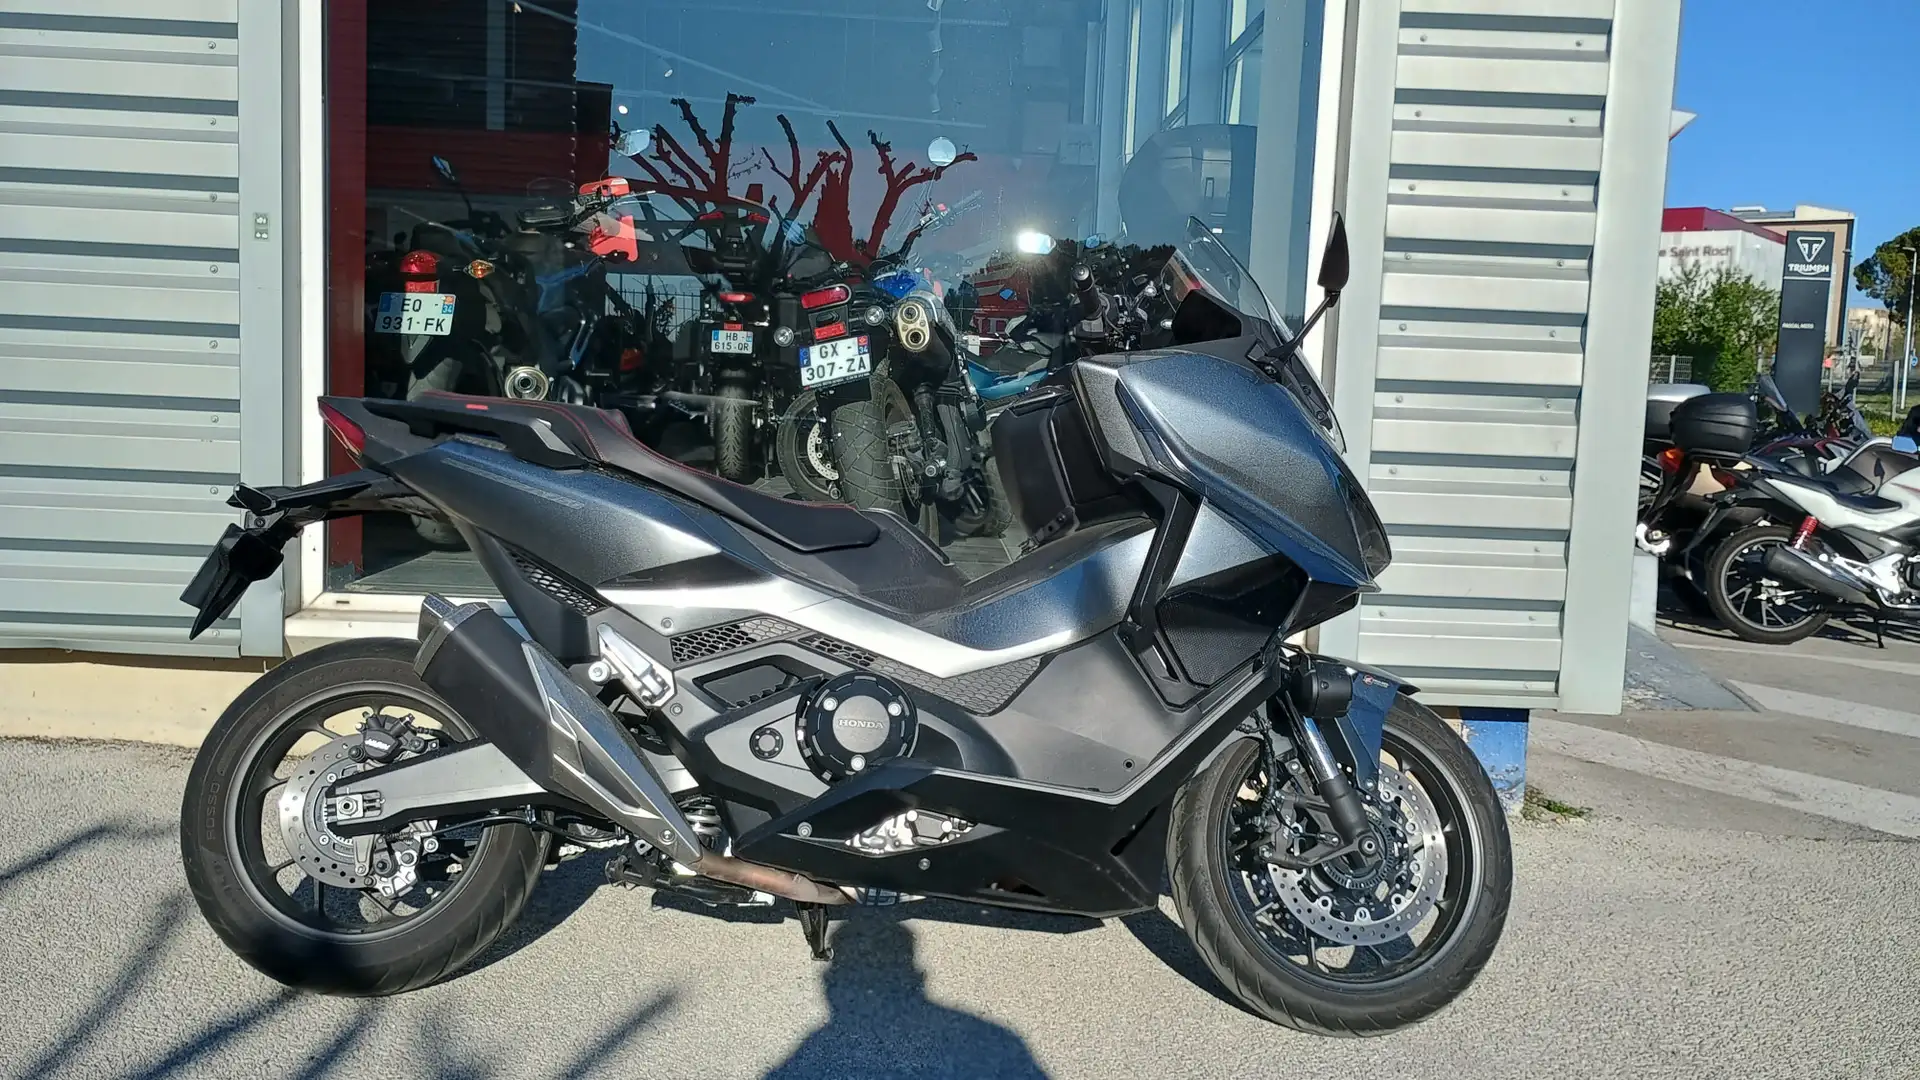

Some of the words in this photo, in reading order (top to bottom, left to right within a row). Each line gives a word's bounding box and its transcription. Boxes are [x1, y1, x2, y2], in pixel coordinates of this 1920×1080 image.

[1788, 263, 1830, 275] TRIUMPH
[725, 332, 738, 341] HB
[819, 343, 839, 359] GX
[806, 356, 867, 381] 307-ZA
[838, 719, 884, 729] HONDA
[206, 782, 220, 840] ROSSO
